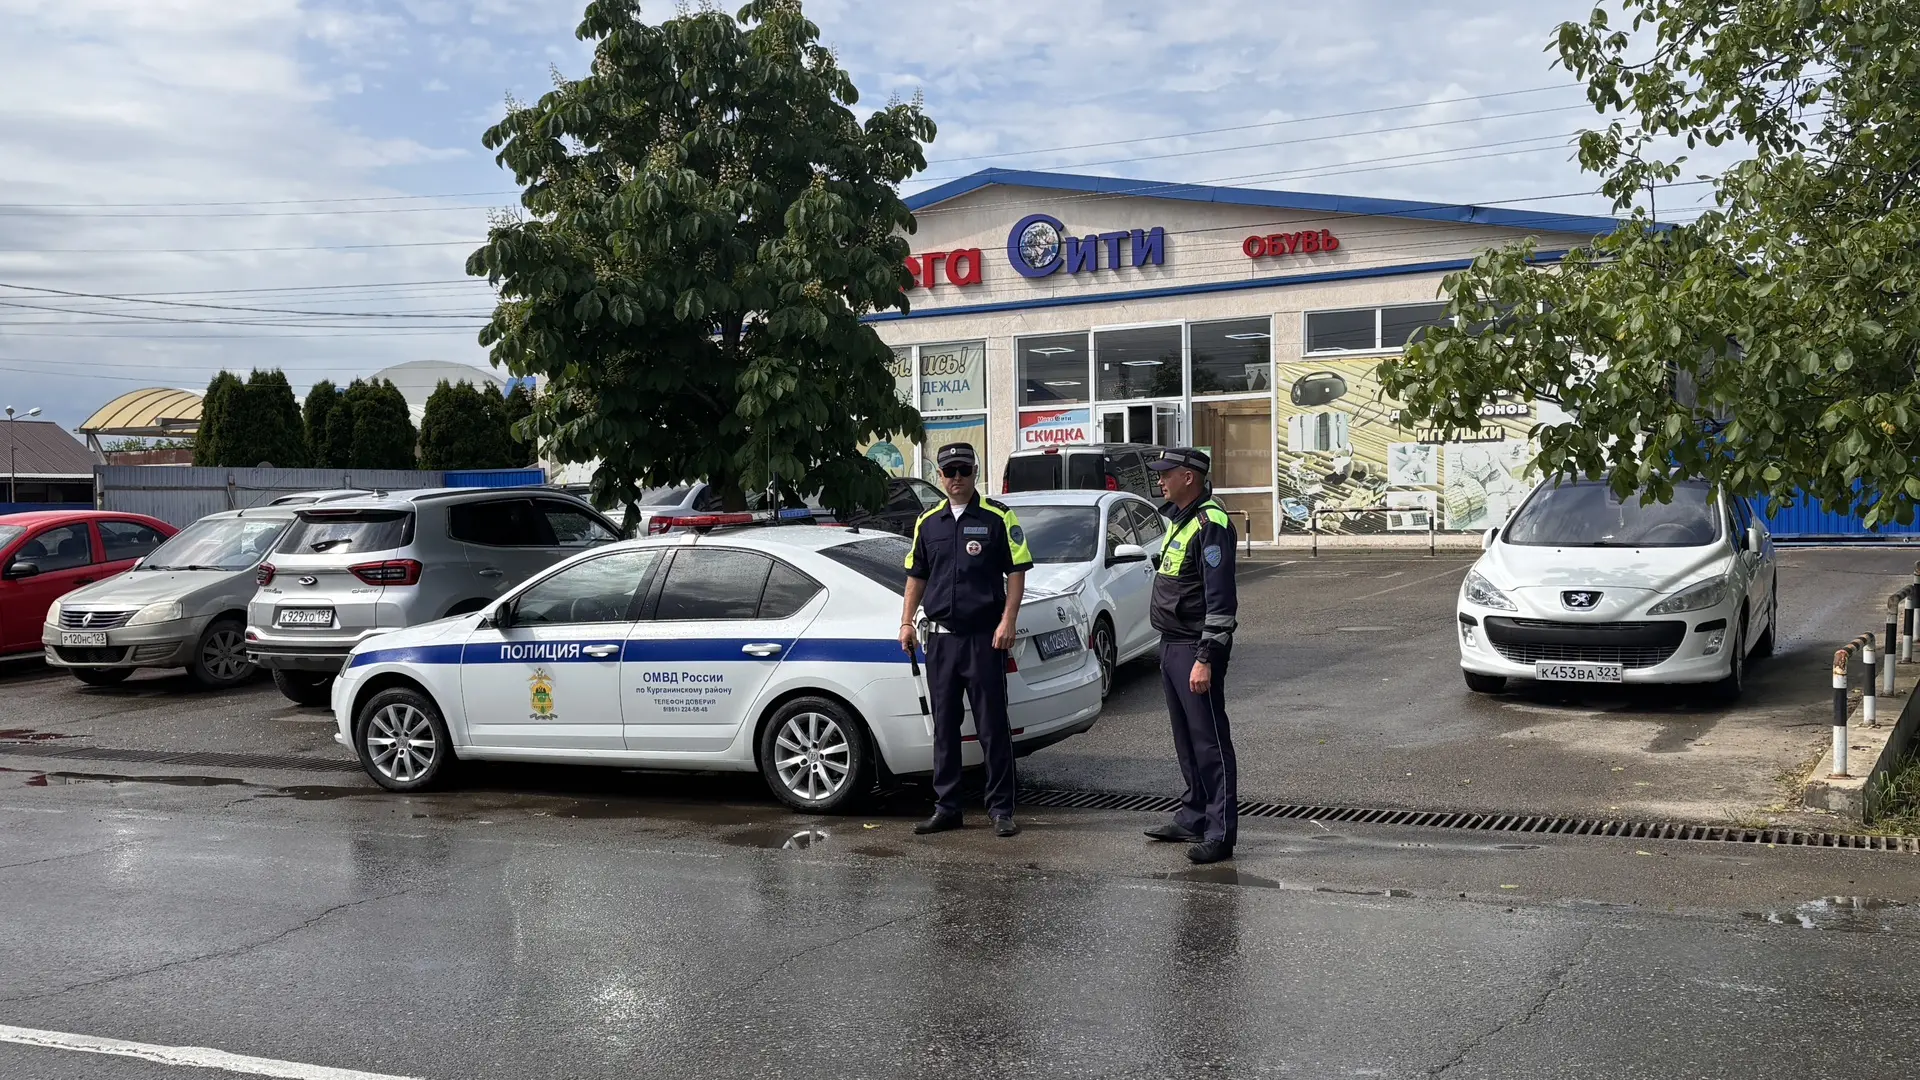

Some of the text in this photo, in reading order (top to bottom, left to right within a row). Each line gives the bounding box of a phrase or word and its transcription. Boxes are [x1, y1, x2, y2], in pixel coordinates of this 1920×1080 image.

[1007, 213, 1164, 278] Сити
[1243, 229, 1340, 258] ОБУВЬ
[911, 379, 970, 395] ДЕЖДА
[1026, 428, 1085, 443] СКИДКА
[282, 610, 315, 622] К929ХО
[501, 643, 580, 661] ПОЛИЦИЯ
[643, 672, 724, 684] ОМВД России
[1541, 665, 1618, 680] К453ВА 323
[647, 686, 702, 695] Курганинскому
[705, 686, 732, 695] району
